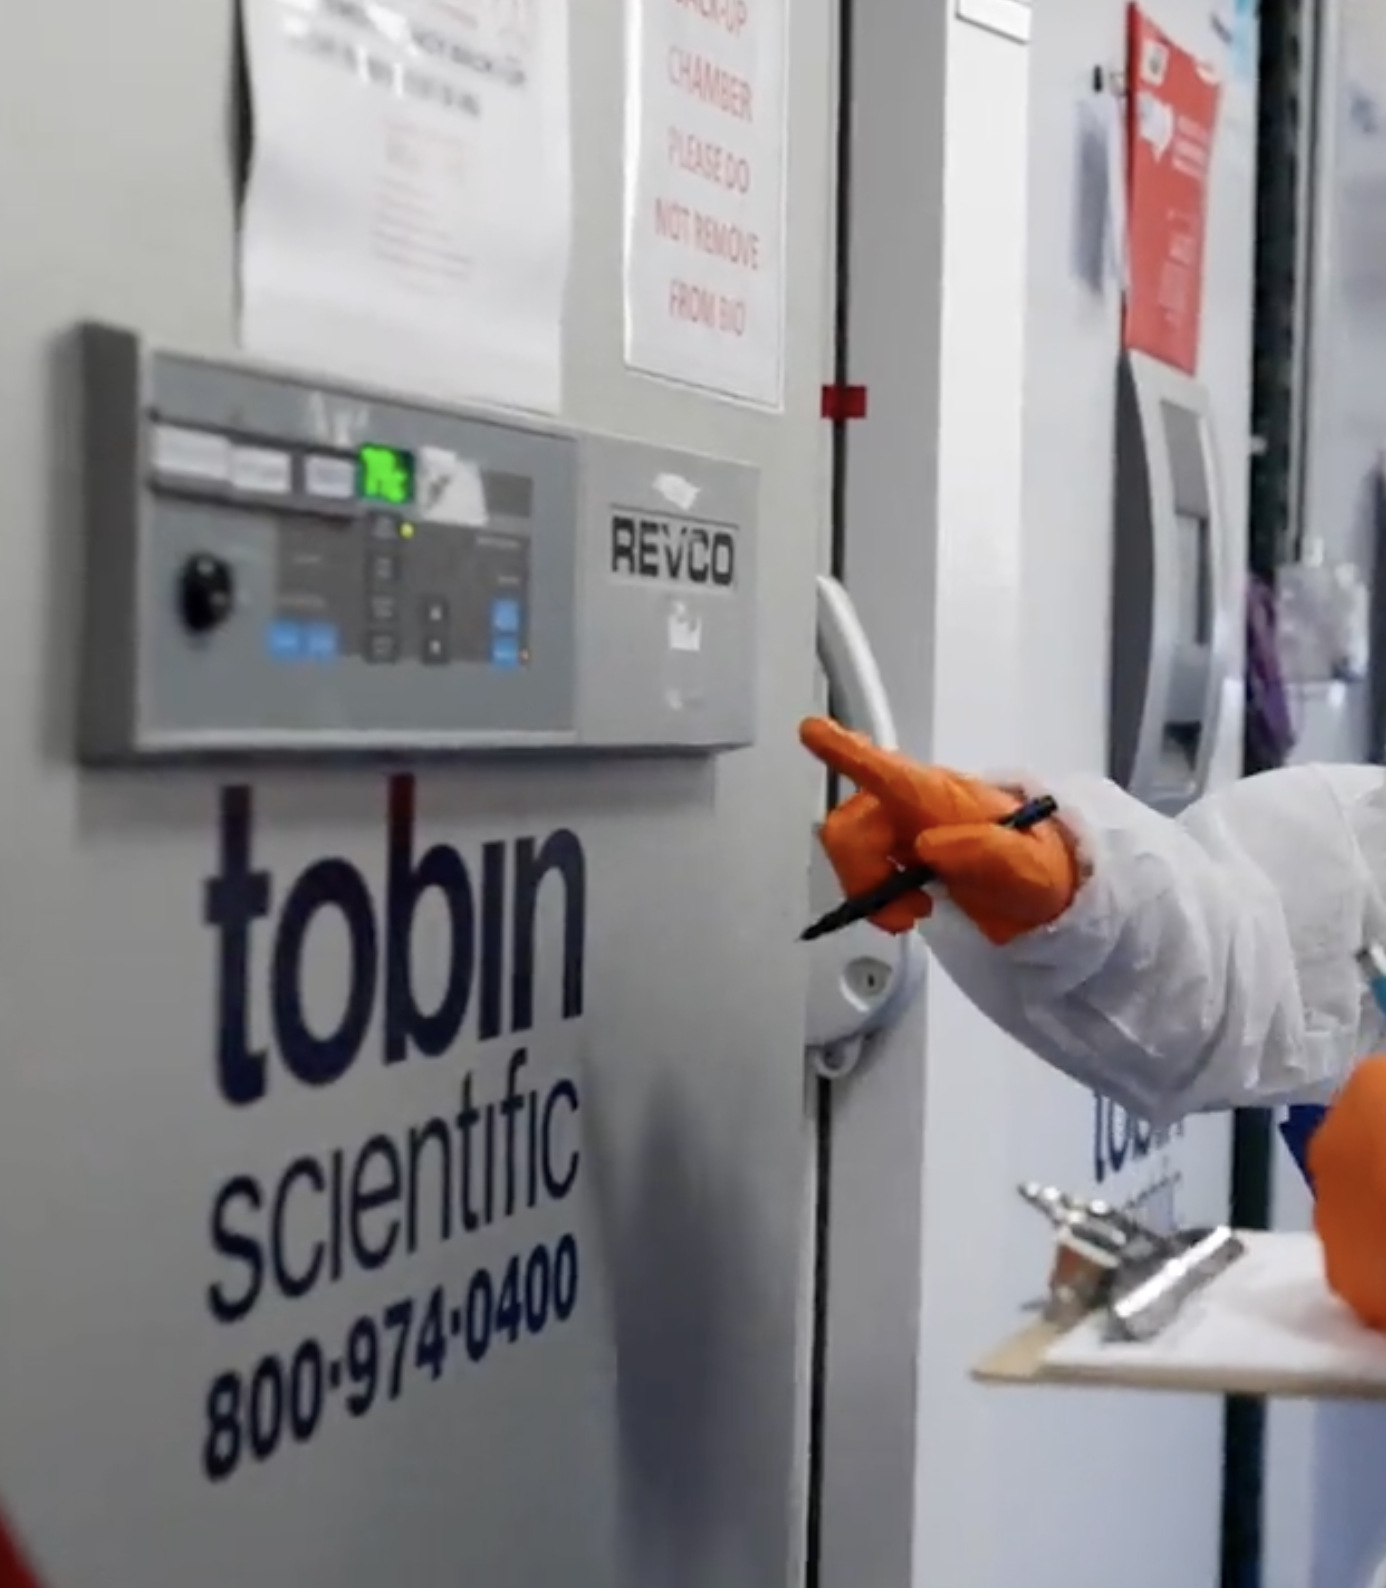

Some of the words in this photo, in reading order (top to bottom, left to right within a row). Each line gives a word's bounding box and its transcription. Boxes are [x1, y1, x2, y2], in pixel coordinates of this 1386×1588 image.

[674, 0, 748, 39] K-UP
[667, 44, 753, 123] CHAMBER
[667, 124, 723, 183] PLEASE
[725, 152, 750, 194] DO
[655, 198, 690, 245] NOT
[693, 209, 759, 270] REMOVE
[669, 278, 716, 330] FROM
[718, 294, 745, 337] BIO
[611, 515, 734, 587] REVCO
[203, 773, 586, 1106] tobin
[208, 1047, 580, 1324] scientific
